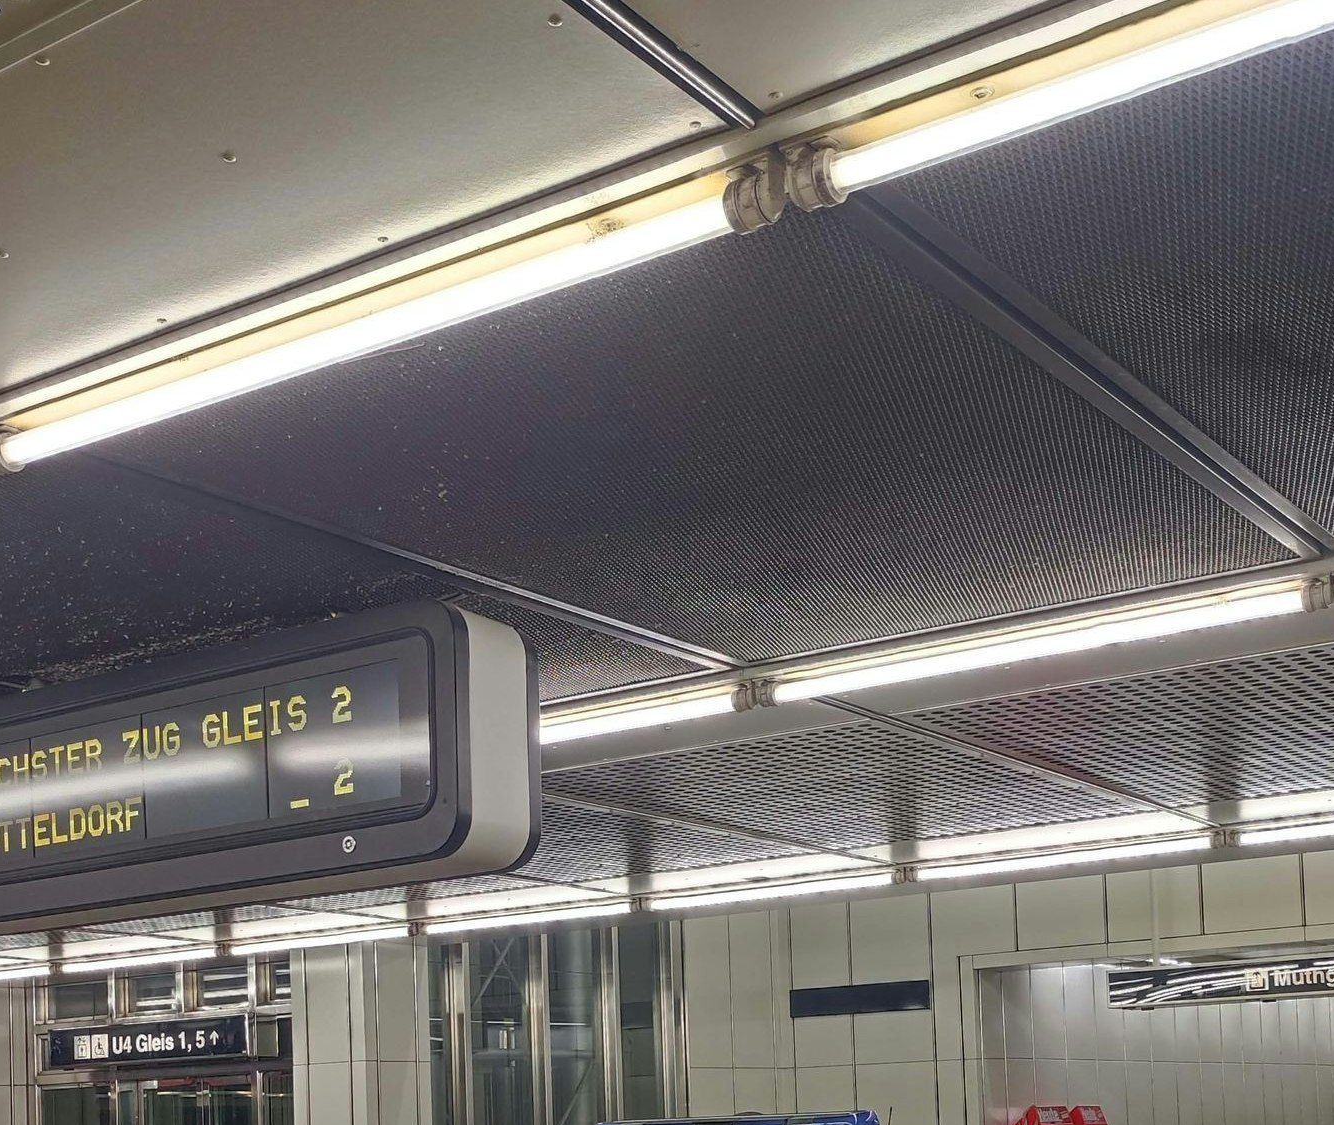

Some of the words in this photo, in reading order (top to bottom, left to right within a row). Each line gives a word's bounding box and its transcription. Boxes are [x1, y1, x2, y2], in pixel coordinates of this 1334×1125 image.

[123, 722, 181, 765] ZUG
[202, 695, 307, 749] GLEIS
[331, 686, 353, 723] 2
[333, 757, 354, 796] 2
[112, 1035, 132, 1055] U4
[136, 1033, 174, 1052] Gleis
[178, 1031, 192, 1053] 1,
[196, 1030, 205, 1048] 5
